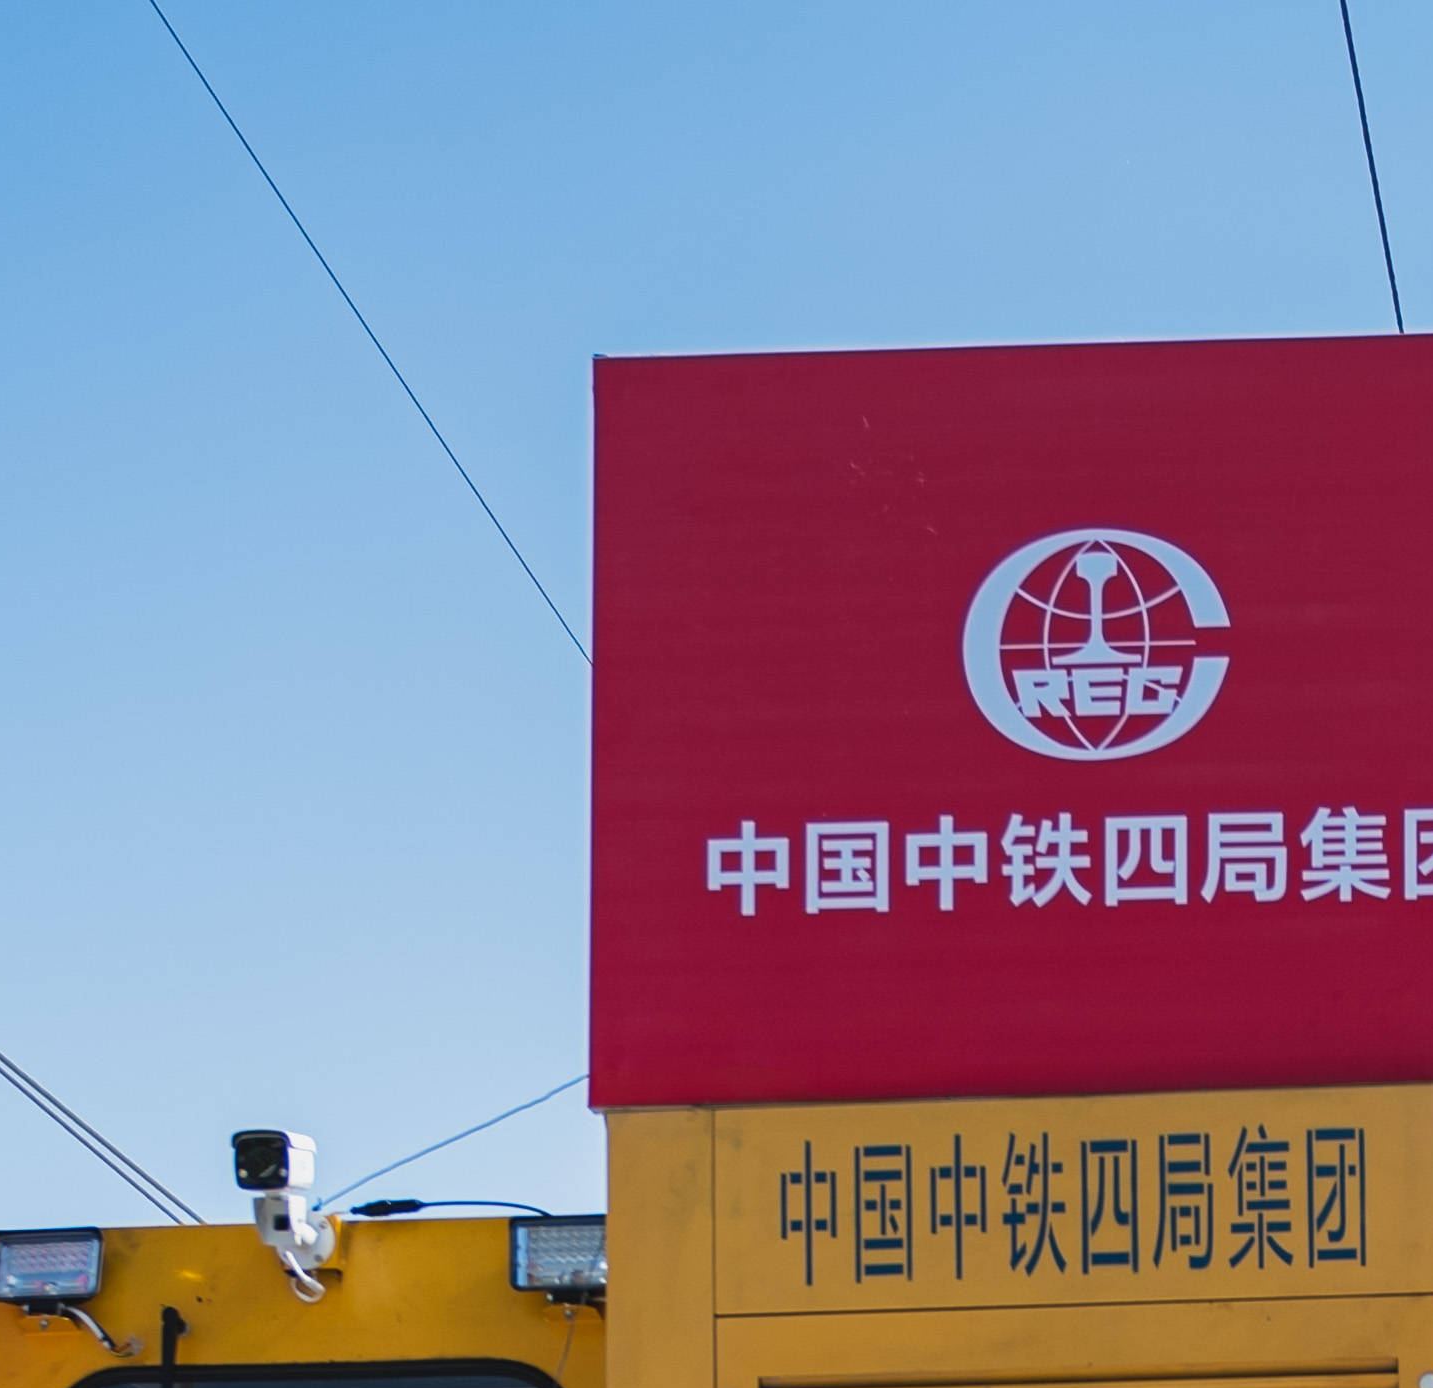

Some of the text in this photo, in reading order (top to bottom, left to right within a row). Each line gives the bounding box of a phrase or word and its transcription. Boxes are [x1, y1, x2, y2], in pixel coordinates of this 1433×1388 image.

[777, 1124, 1368, 1288] 中国中铁四局集团
